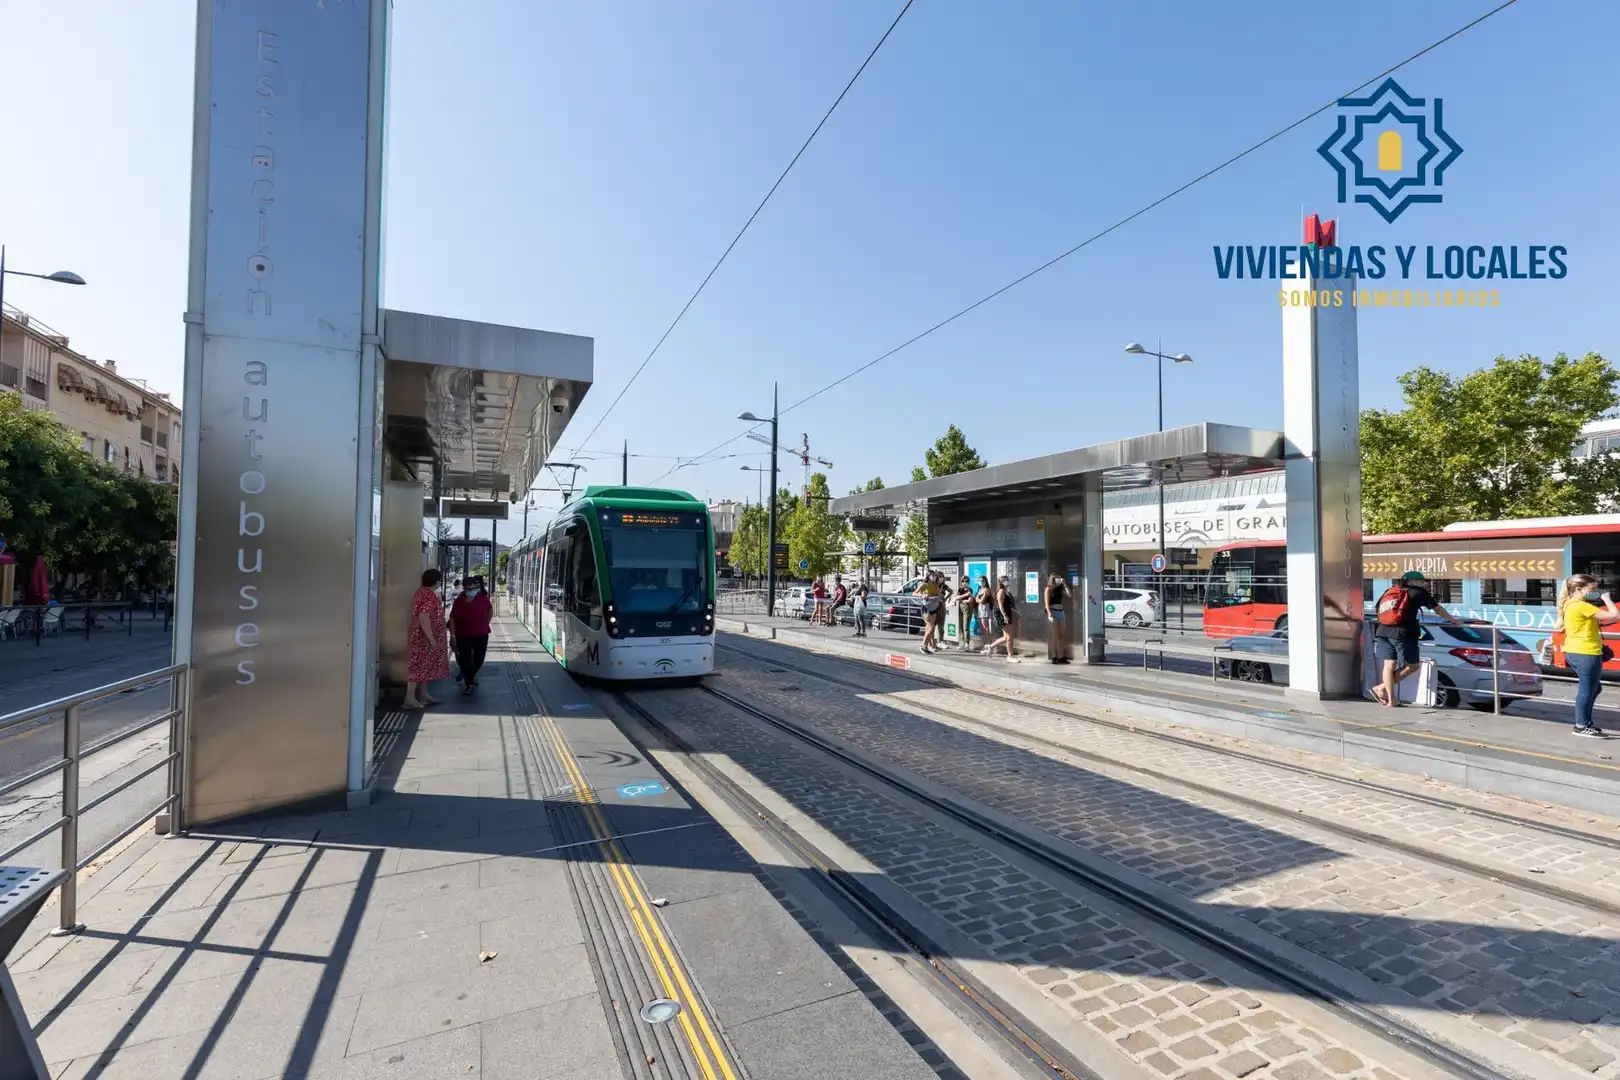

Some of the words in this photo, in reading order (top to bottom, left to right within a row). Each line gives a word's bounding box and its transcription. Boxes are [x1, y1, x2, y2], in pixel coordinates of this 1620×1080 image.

[1304, 214, 1336, 247] M
[234, 359, 268, 685] autobuses
[1103, 520, 1192, 537] AUTOBUSES
[1203, 518, 1225, 532] DE
[1403, 557, 1414, 573] LA
[1415, 556, 1448, 573] PEPITA
[586, 639, 600, 666] M
